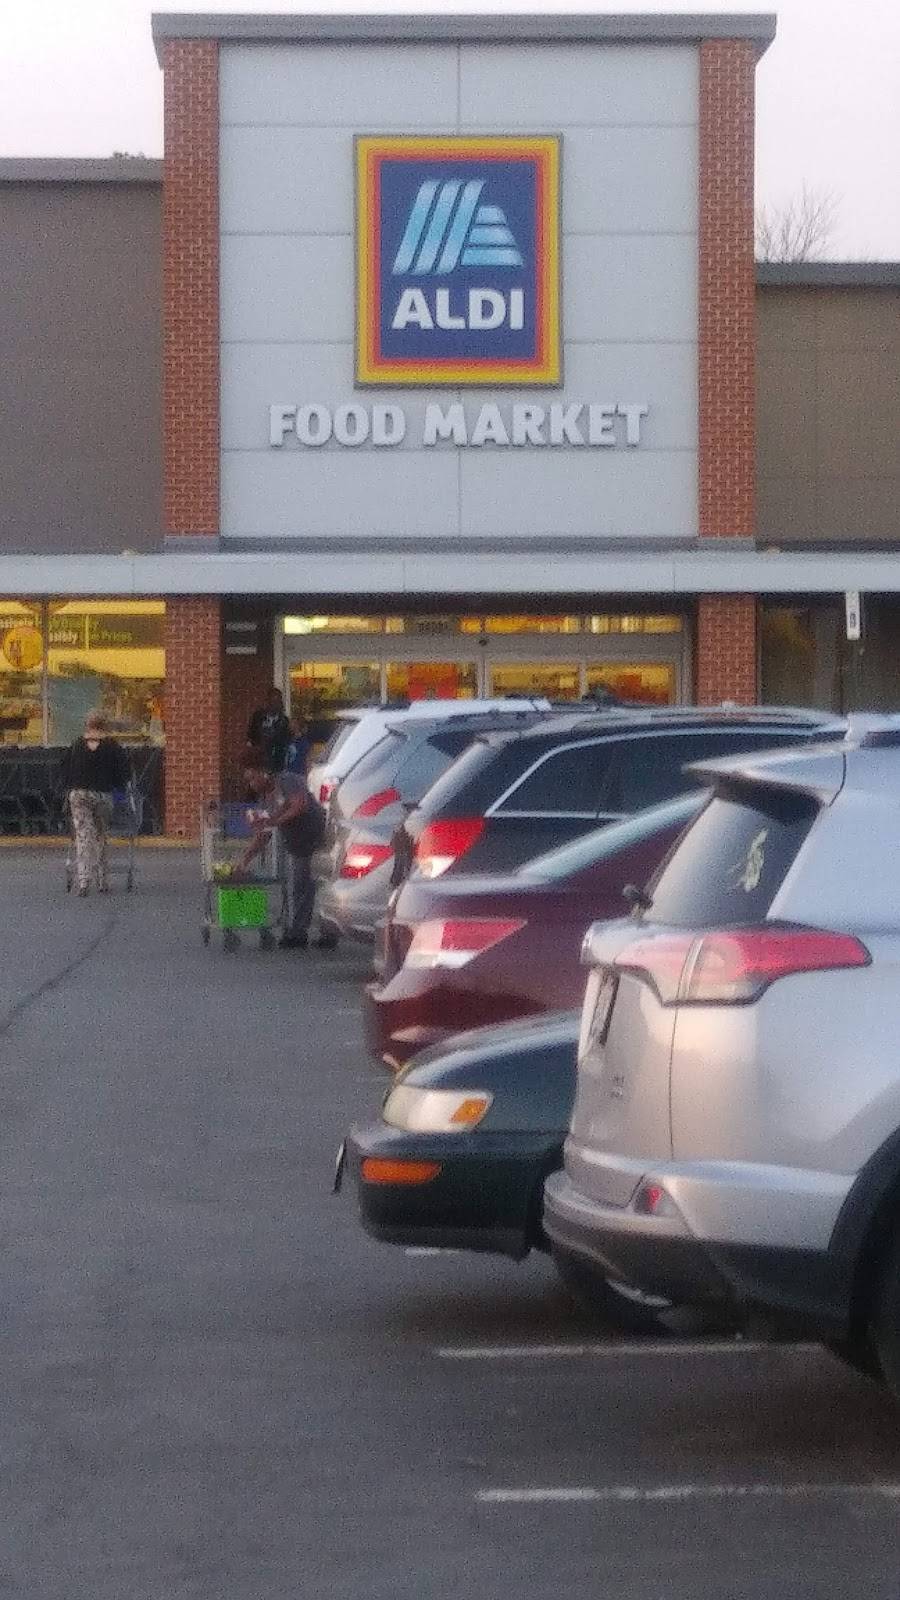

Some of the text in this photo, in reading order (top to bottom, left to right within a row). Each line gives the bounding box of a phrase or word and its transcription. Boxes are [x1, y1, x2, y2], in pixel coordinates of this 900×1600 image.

[392, 288, 525, 330] ALDI
[268, 403, 649, 447] FOOD MARKET
